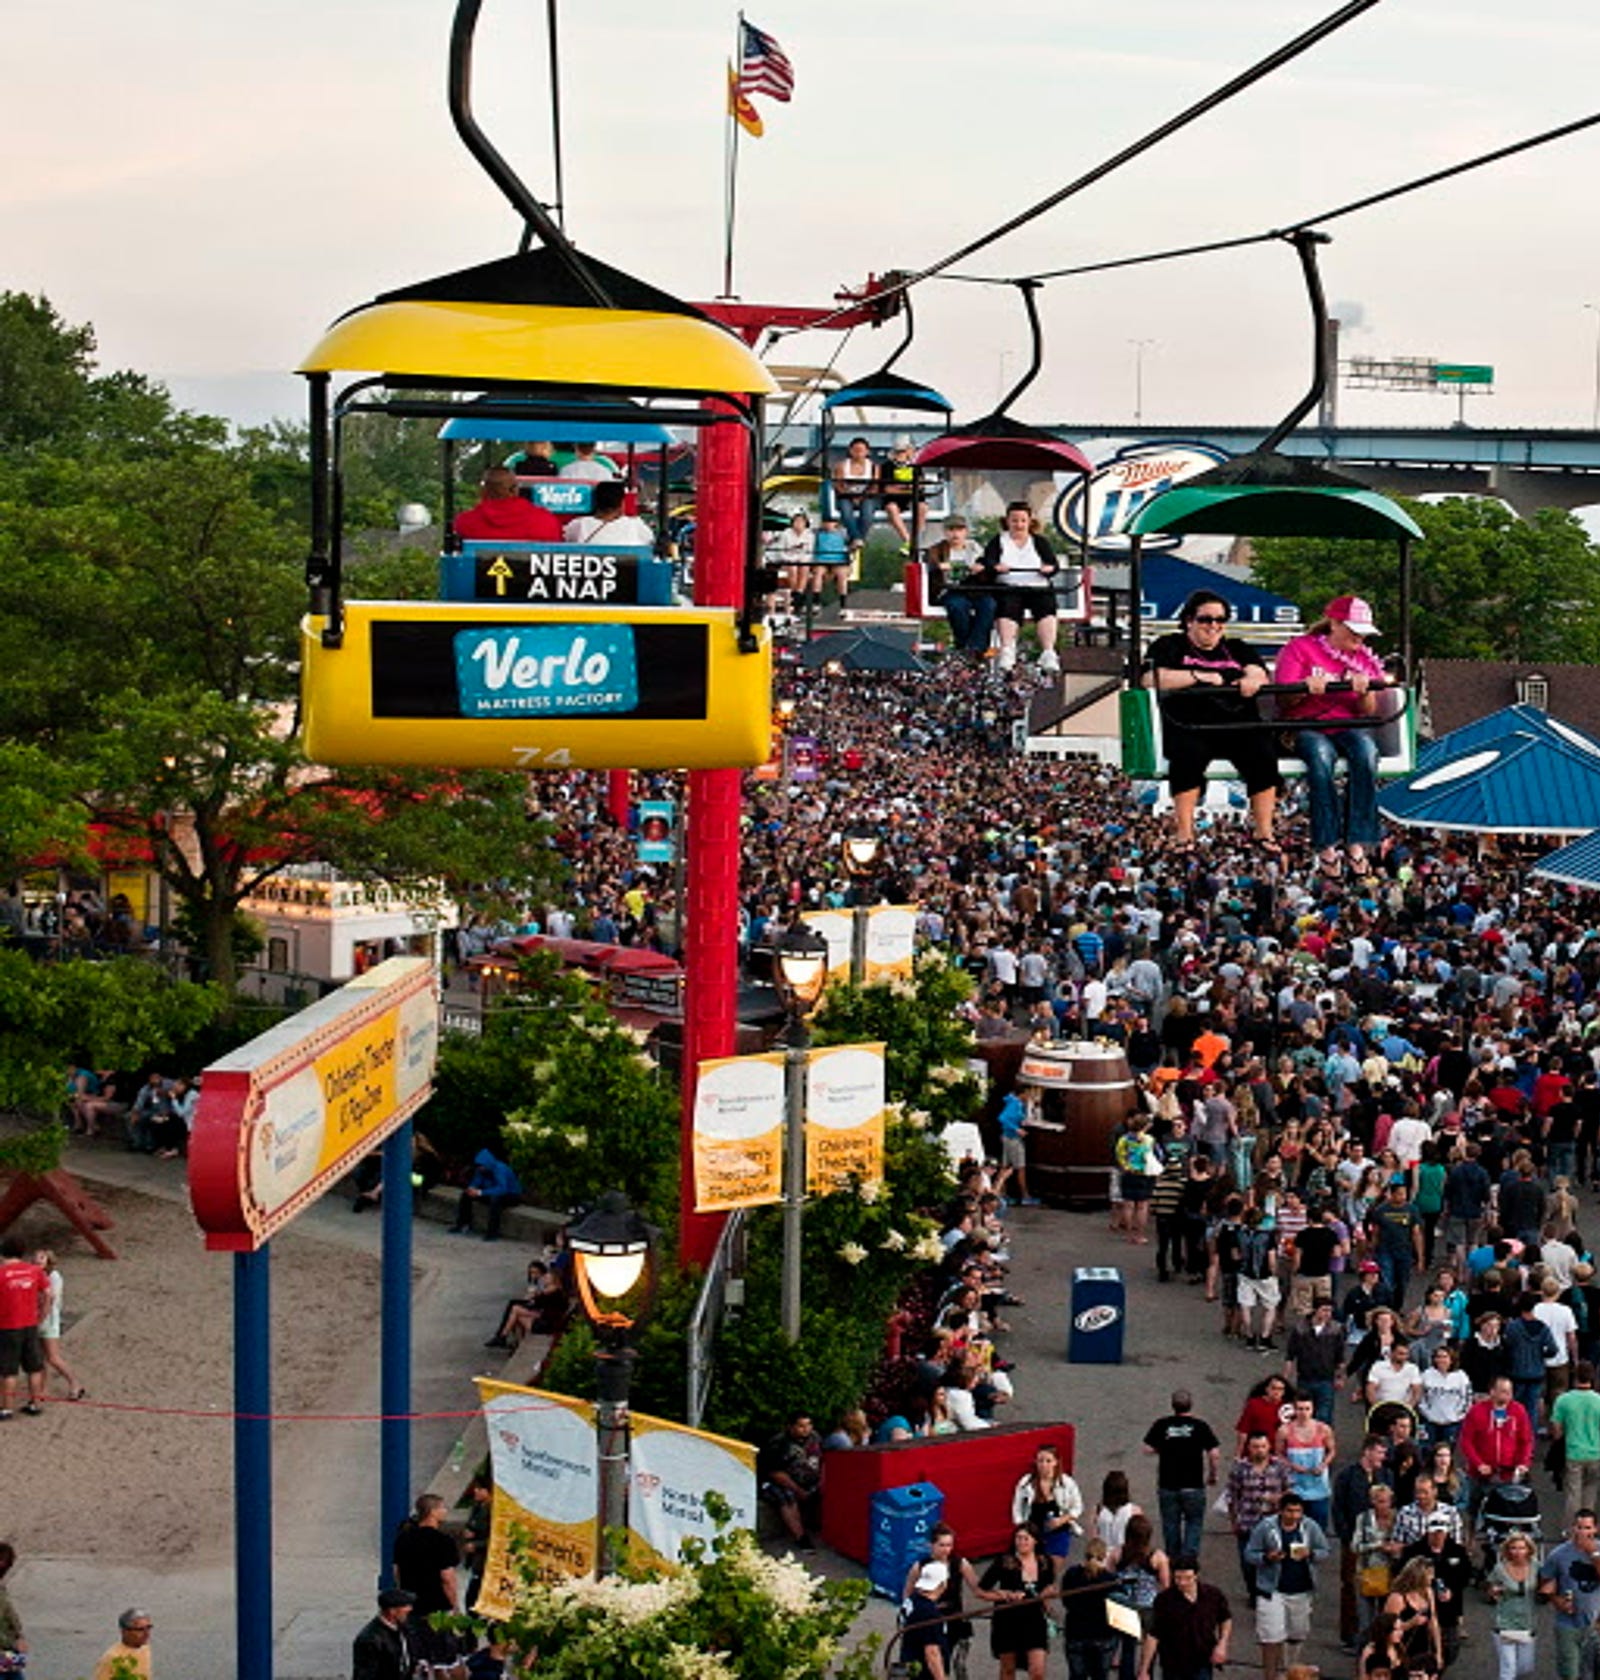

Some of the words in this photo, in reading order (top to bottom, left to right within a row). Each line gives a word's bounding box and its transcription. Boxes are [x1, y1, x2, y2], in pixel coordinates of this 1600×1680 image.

[1115, 460, 1190, 488] Miller
[529, 553, 618, 578] NEEDS
[527, 579, 550, 599] A
[556, 579, 617, 601] NAP
[470, 636, 611, 690] Verlo
[476, 695, 551, 711] MATTRESS
[555, 692, 623, 707] FACTORY
[511, 746, 574, 767] 74
